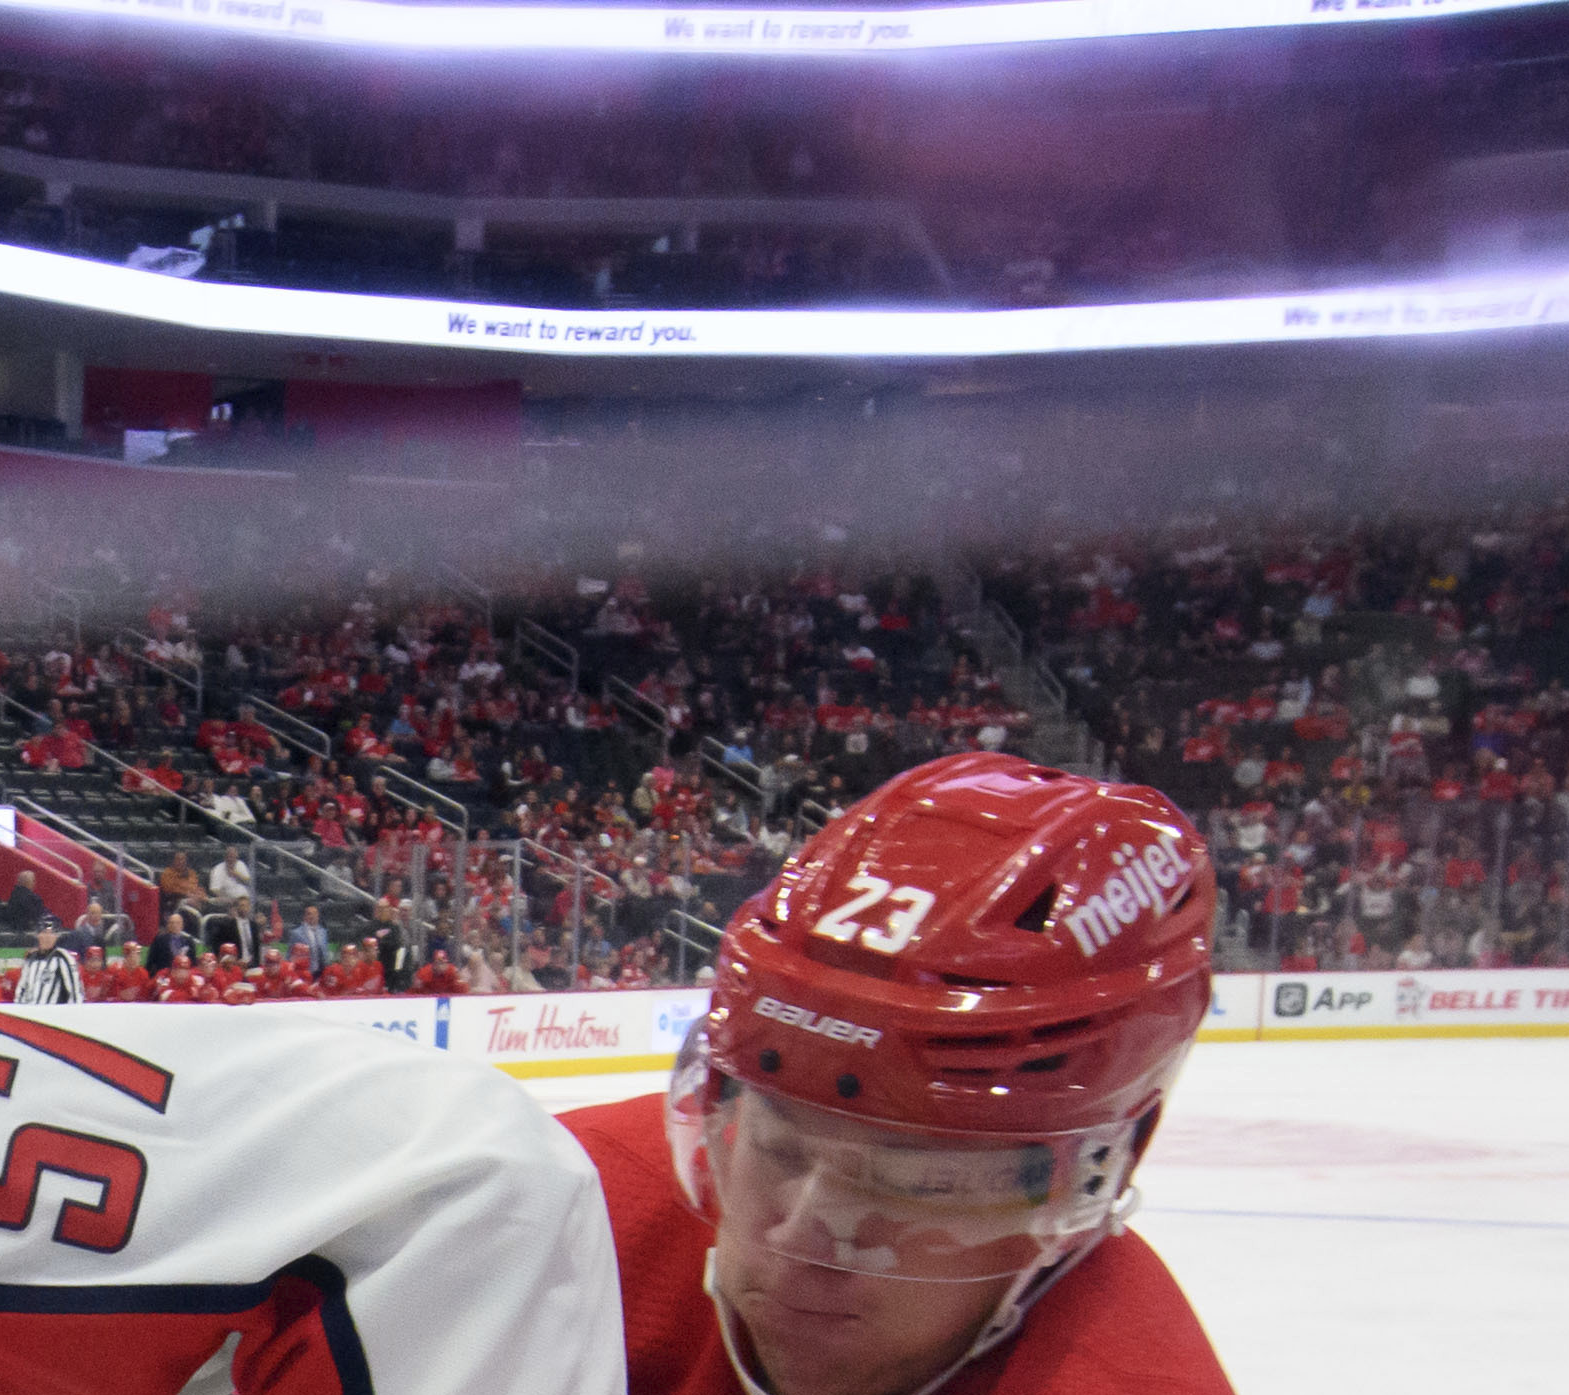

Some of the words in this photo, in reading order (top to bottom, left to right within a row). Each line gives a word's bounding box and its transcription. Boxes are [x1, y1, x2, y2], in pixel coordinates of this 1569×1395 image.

[448, 312, 477, 334] We
[484, 319, 532, 338] want
[539, 319, 557, 340] to
[564, 320, 645, 341] reward
[649, 325, 697, 346] you.
[815, 875, 937, 955] 23
[1064, 834, 1194, 958] meijer
[1427, 989, 1521, 1011] BELLE
[487, 1006, 527, 1053] Tim
[532, 1003, 620, 1052] Hortons
